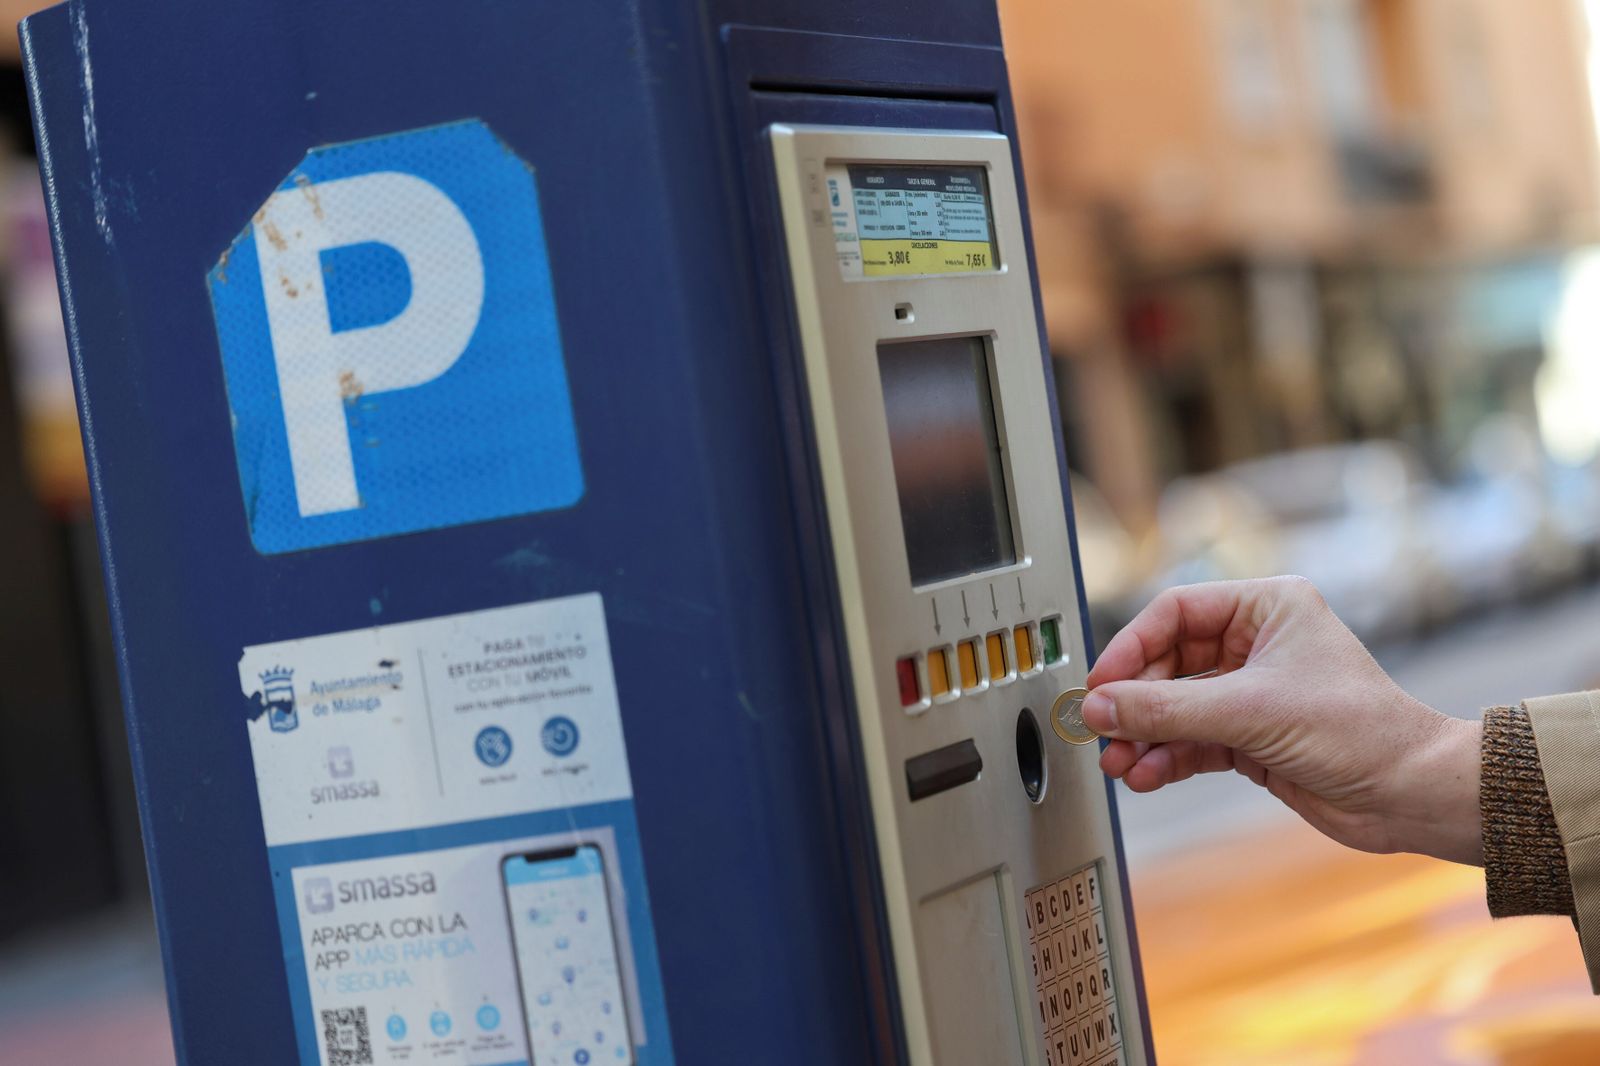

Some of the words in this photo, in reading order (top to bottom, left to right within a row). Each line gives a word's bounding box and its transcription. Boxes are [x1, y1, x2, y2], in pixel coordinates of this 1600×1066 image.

[253, 171, 485, 517] P
[448, 646, 587, 679] ESTACIONAMIENTO
[312, 702, 330, 717] de
[310, 780, 380, 804] smassa
[337, 871, 437, 903] smassa
[1036, 902, 1044, 924] B
[1049, 895, 1058, 917] C
[1063, 889, 1071, 912] D
[1075, 884, 1084, 906] E
[1088, 878, 1096, 900] F
[311, 921, 386, 947] APARCA
[390, 916, 434, 939] CON
[438, 912, 468, 934] LA
[314, 950, 350, 971] APP
[1043, 948, 1051, 971] H
[1071, 935, 1078, 957] J
[1083, 929, 1091, 951] K
[1095, 924, 1103, 945] L
[316, 975, 329, 994] Y
[336, 969, 414, 993] SEGURA
[1049, 994, 1059, 1019] N
[1063, 988, 1072, 1010] O
[1076, 982, 1083, 1004] P
[1089, 975, 1098, 997] Q
[1102, 968, 1111, 990] R
[1056, 1041, 1064, 1064] T
[1069, 1034, 1078, 1057] U
[1083, 1027, 1091, 1049] V
[1095, 1019, 1105, 1043] W
[1108, 1013, 1117, 1036] X
